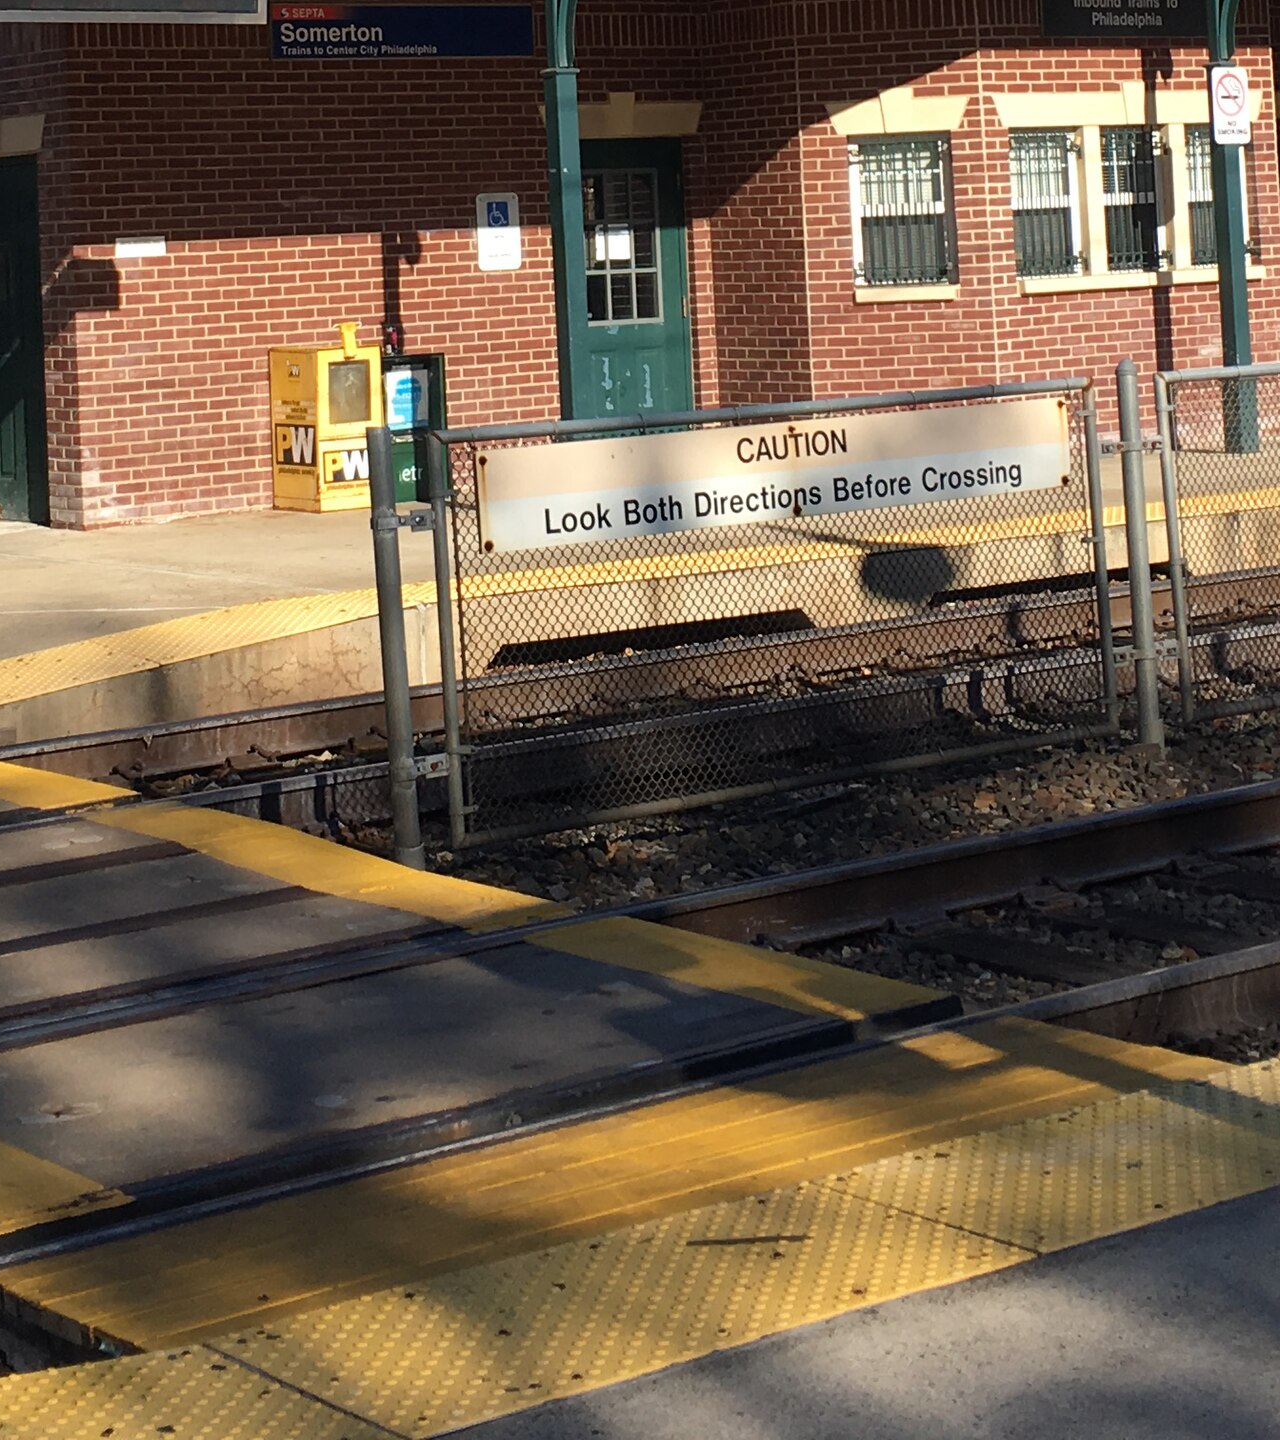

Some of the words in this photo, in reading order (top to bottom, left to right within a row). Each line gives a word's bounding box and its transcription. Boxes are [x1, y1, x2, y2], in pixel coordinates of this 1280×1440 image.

[292, 8, 325, 18] SEPTA
[1092, 12, 1163, 28] Philadelphia
[280, 23, 383, 43] Somerton
[281, 46, 312, 55] Trains
[314, 46, 324, 55] to
[326, 46, 357, 55] Center
[360, 45, 379, 56] City
[381, 44, 438, 56] Philadelphia
[276, 426, 314, 464] PW
[736, 428, 848, 463] CAUTION
[324, 449, 369, 483] PW
[544, 502, 612, 535] Look
[623, 495, 684, 526] Both
[694, 484, 823, 518] Directions
[833, 474, 912, 503] Before
[922, 461, 1023, 492] Crossing
